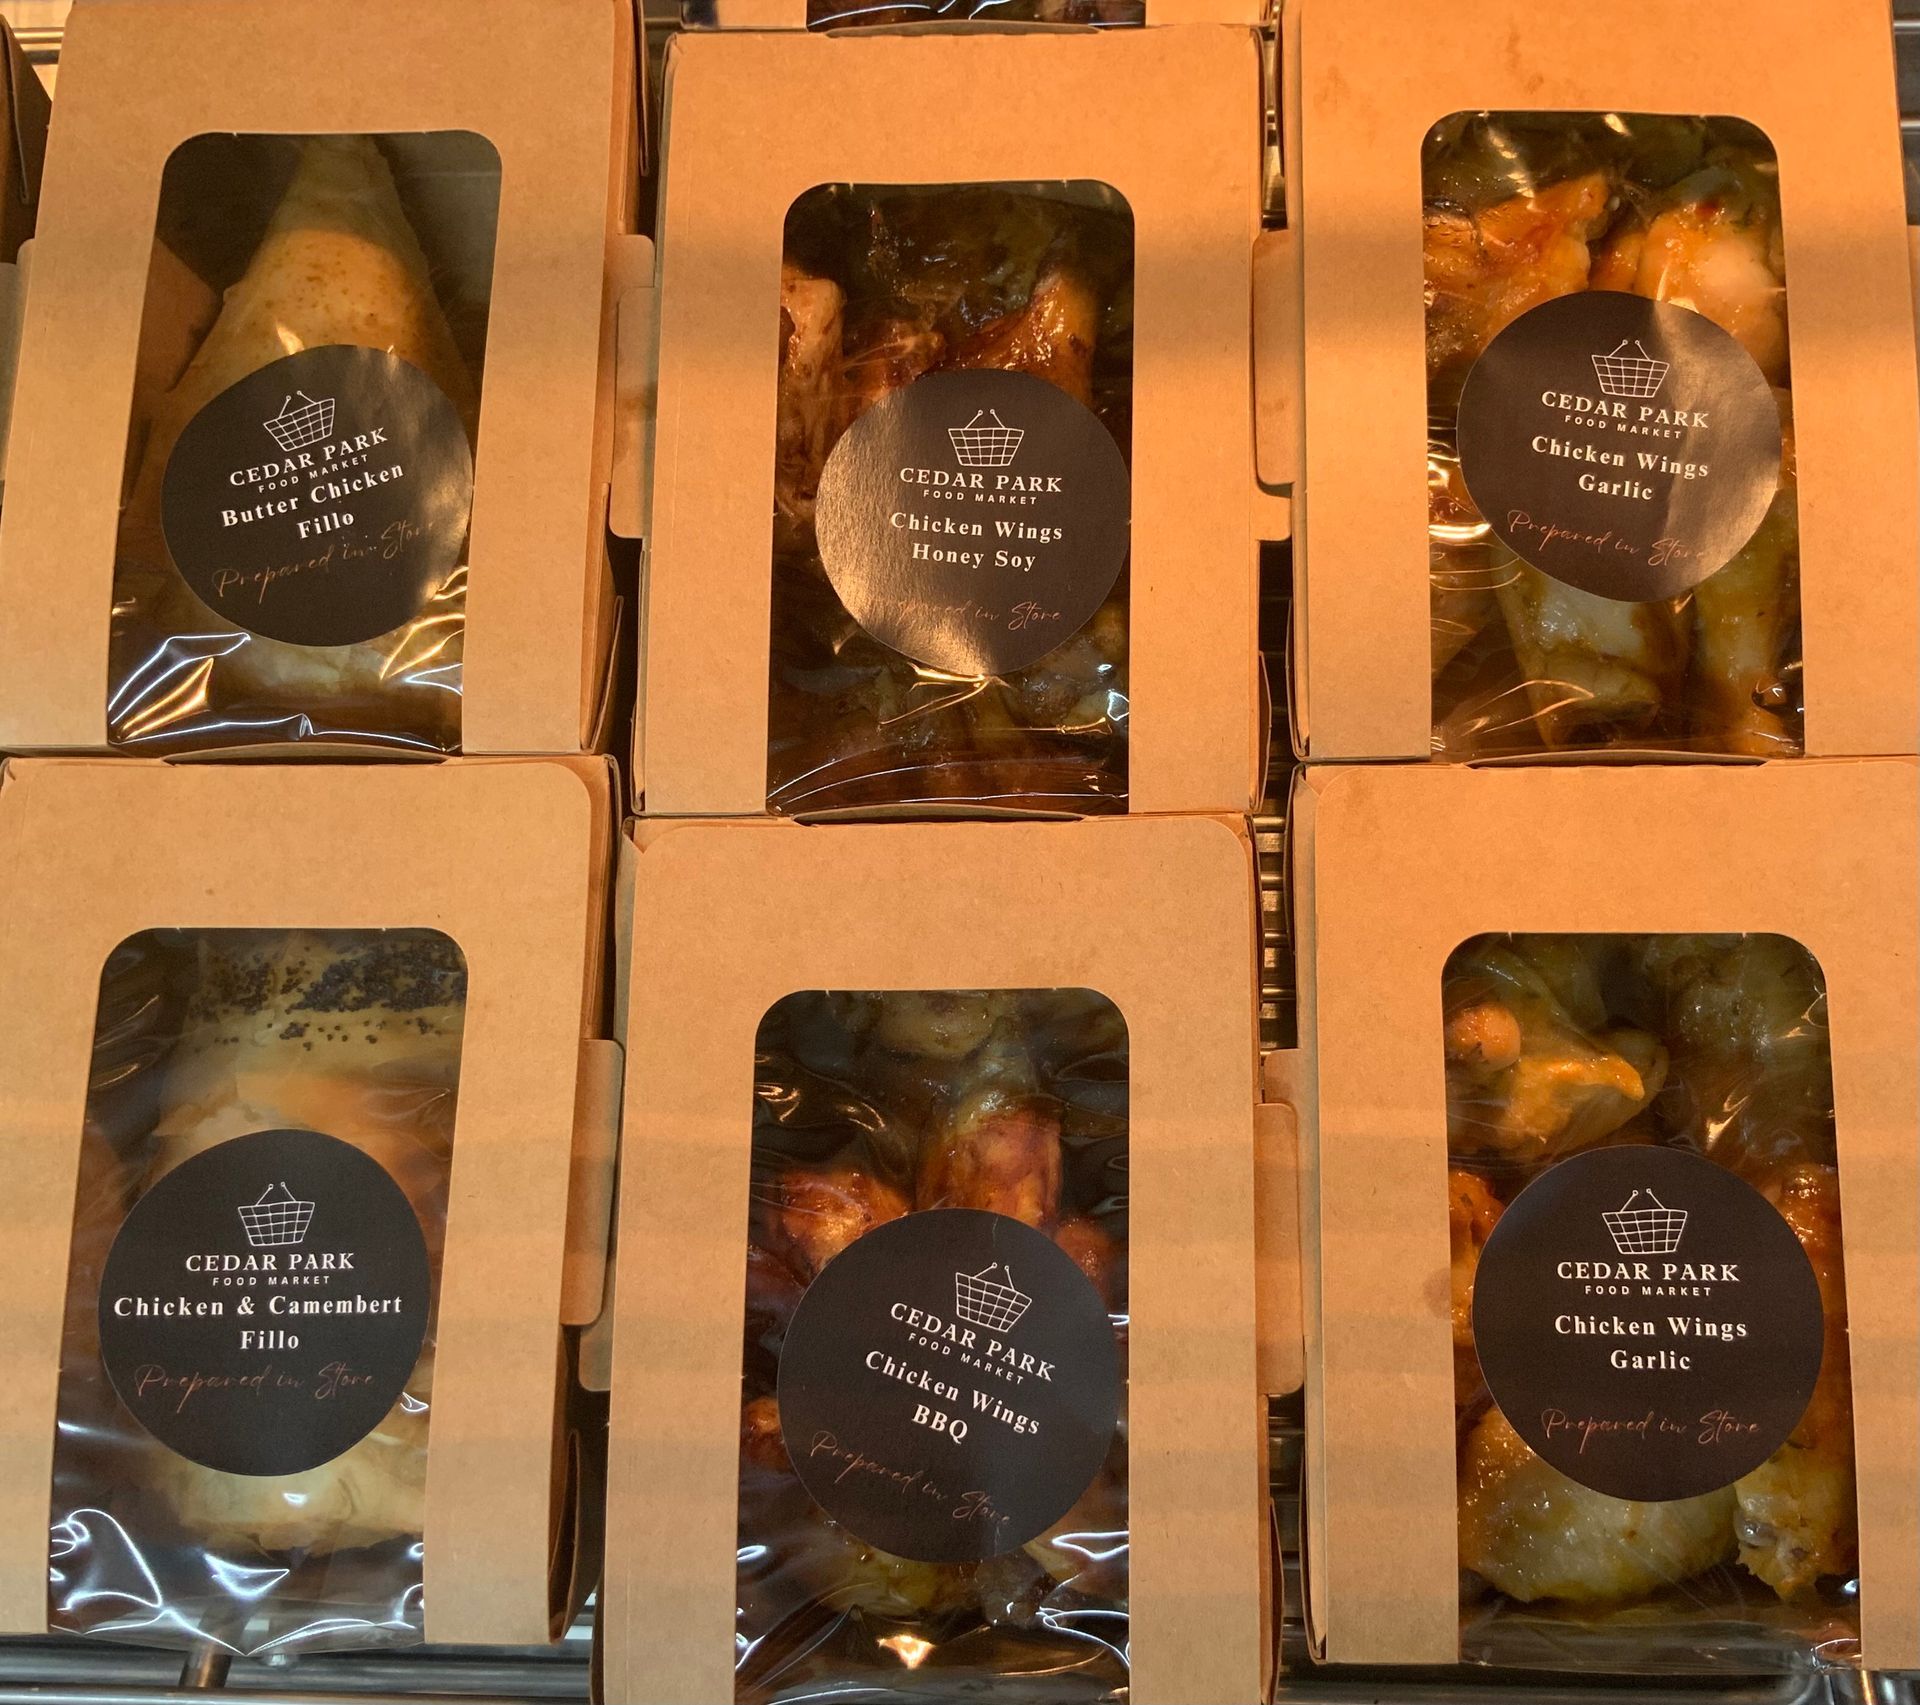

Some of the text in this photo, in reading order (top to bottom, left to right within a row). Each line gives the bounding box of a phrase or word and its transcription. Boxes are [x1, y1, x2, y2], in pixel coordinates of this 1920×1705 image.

[1541, 391, 1709, 428] CEDAR PARK
[1565, 415, 1682, 439] FOOD MARKET
[229, 427, 388, 486] CEDAR PARK
[1532, 436, 1709, 480] Chicken Wings
[259, 454, 369, 493] FOOD MARKET
[900, 467, 1063, 492] CEDAR PARK
[1579, 474, 1653, 500] Garlic
[221, 464, 404, 527] Butter Chicken
[924, 489, 1037, 504] FOOD MARKET
[297, 512, 355, 539] Fillo
[890, 512, 1063, 543] Chicken Wings
[912, 543, 1036, 571] Honey Soy
[1615, 539, 1639, 554] in
[186, 1253, 354, 1272] CEDAR PARK
[1557, 1261, 1740, 1281] CEDAR PARK
[213, 1276, 329, 1286] FOOD MARKET
[1585, 1285, 1712, 1296] FOOD MARKET
[114, 1295, 402, 1316] Chicken & Camembert
[240, 1331, 299, 1350] Fillo
[1555, 1315, 1747, 1341] Chicken Wings
[891, 1302, 1055, 1382] CEDAR PARK
[909, 1333, 1024, 1384] FOOD MARKET
[1610, 1350, 1691, 1370] Garlic
[134, 1361, 374, 1413] Prepared in Store
[865, 1350, 1040, 1435] Chicken Wings
[912, 1404, 968, 1444] BBQ
[1542, 1409, 1761, 1454] Prepared in Store
[811, 1430, 923, 1493] Prepared
